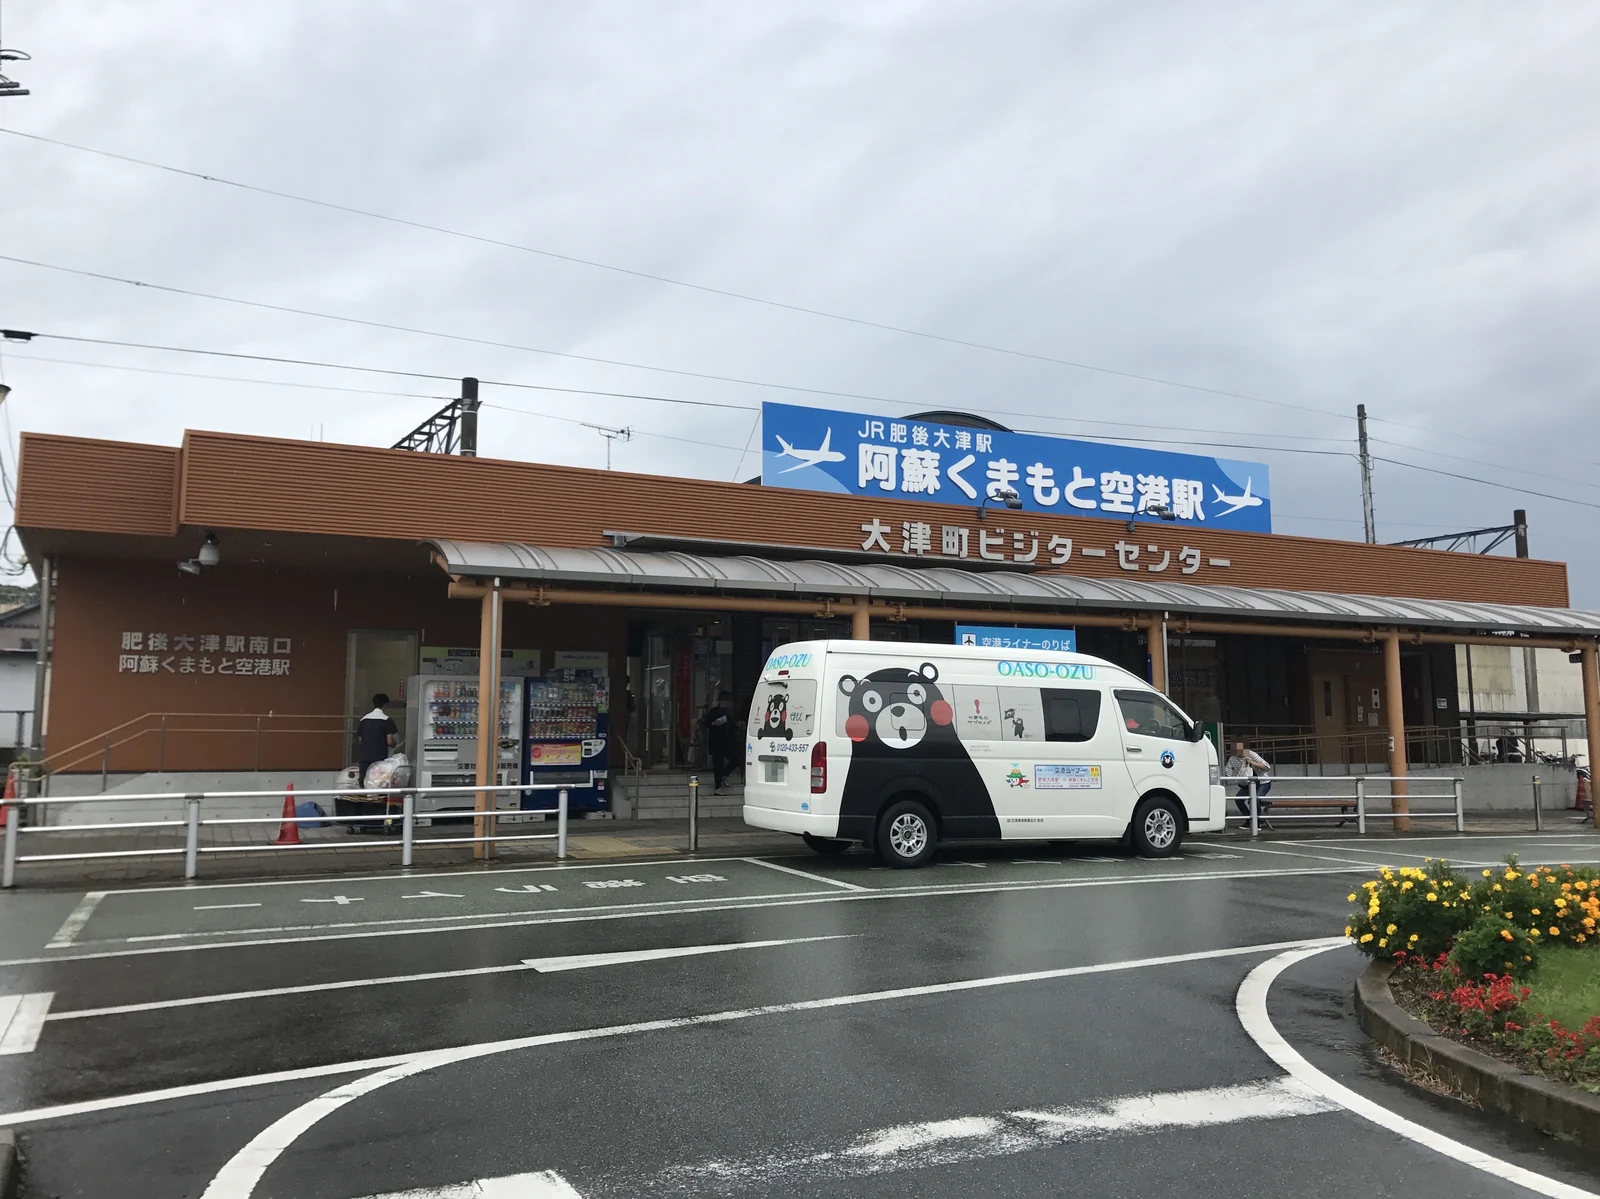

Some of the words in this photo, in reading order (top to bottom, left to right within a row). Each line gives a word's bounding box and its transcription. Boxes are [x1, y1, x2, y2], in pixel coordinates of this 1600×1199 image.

[858, 419, 993, 453] JR肥後大津駅
[858, 443, 1205, 521] 阿蘇くまもと空港駅
[860, 518, 1232, 575] 大津町ビジターセンター
[121, 631, 292, 655] 肥後大津駅南口
[981, 636, 1071, 651] 空港ライナーのりば
[118, 654, 290, 676] 阿蘇くまもと空港駅
[765, 653, 812, 671] OASO-OZU
[997, 661, 1095, 681] OASO-OZU
[777, 743, 809, 752] 0120-433-557
